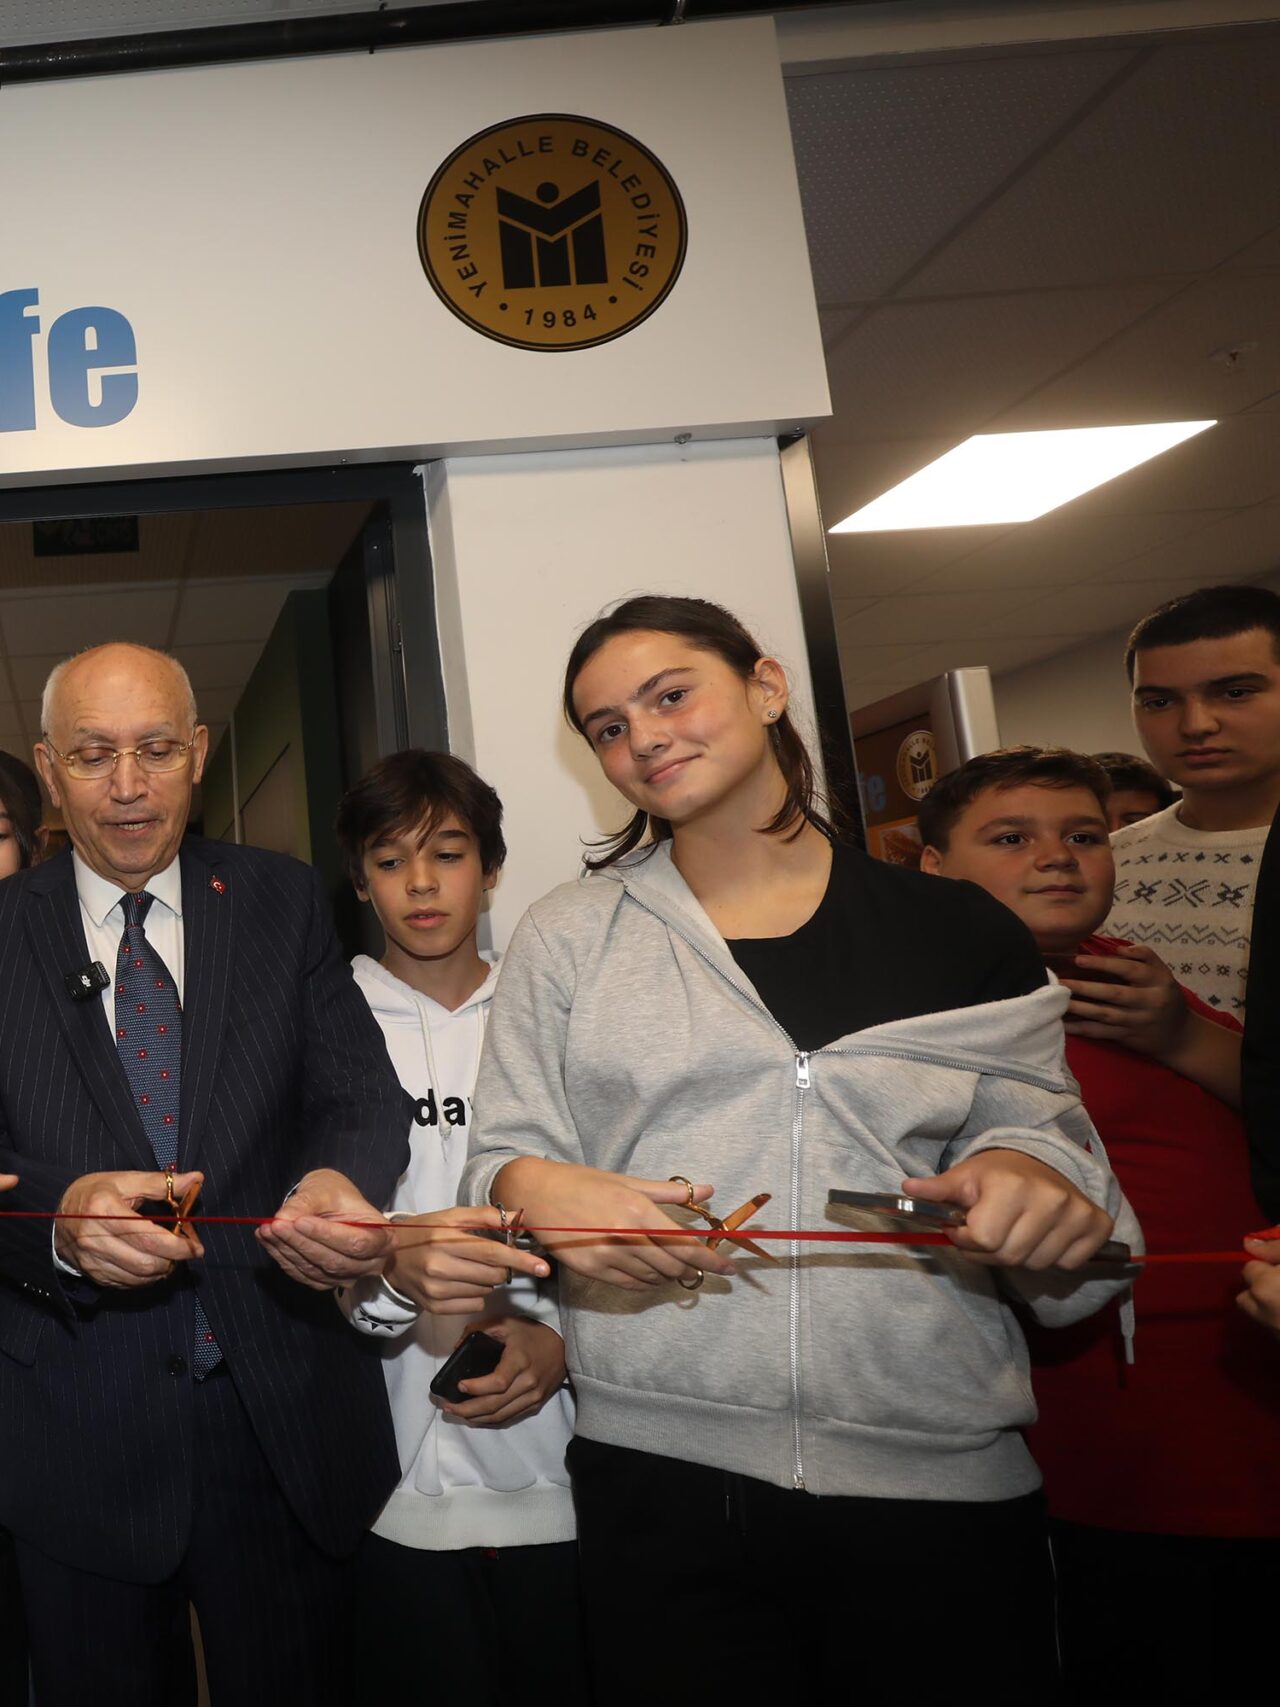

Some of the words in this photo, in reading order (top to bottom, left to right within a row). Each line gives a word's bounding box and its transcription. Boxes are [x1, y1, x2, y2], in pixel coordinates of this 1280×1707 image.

[444, 136, 553, 298] YENİMAHALLE
[571, 138, 661, 291] BELEDİYESİ
[524, 303, 597, 328] 1984
